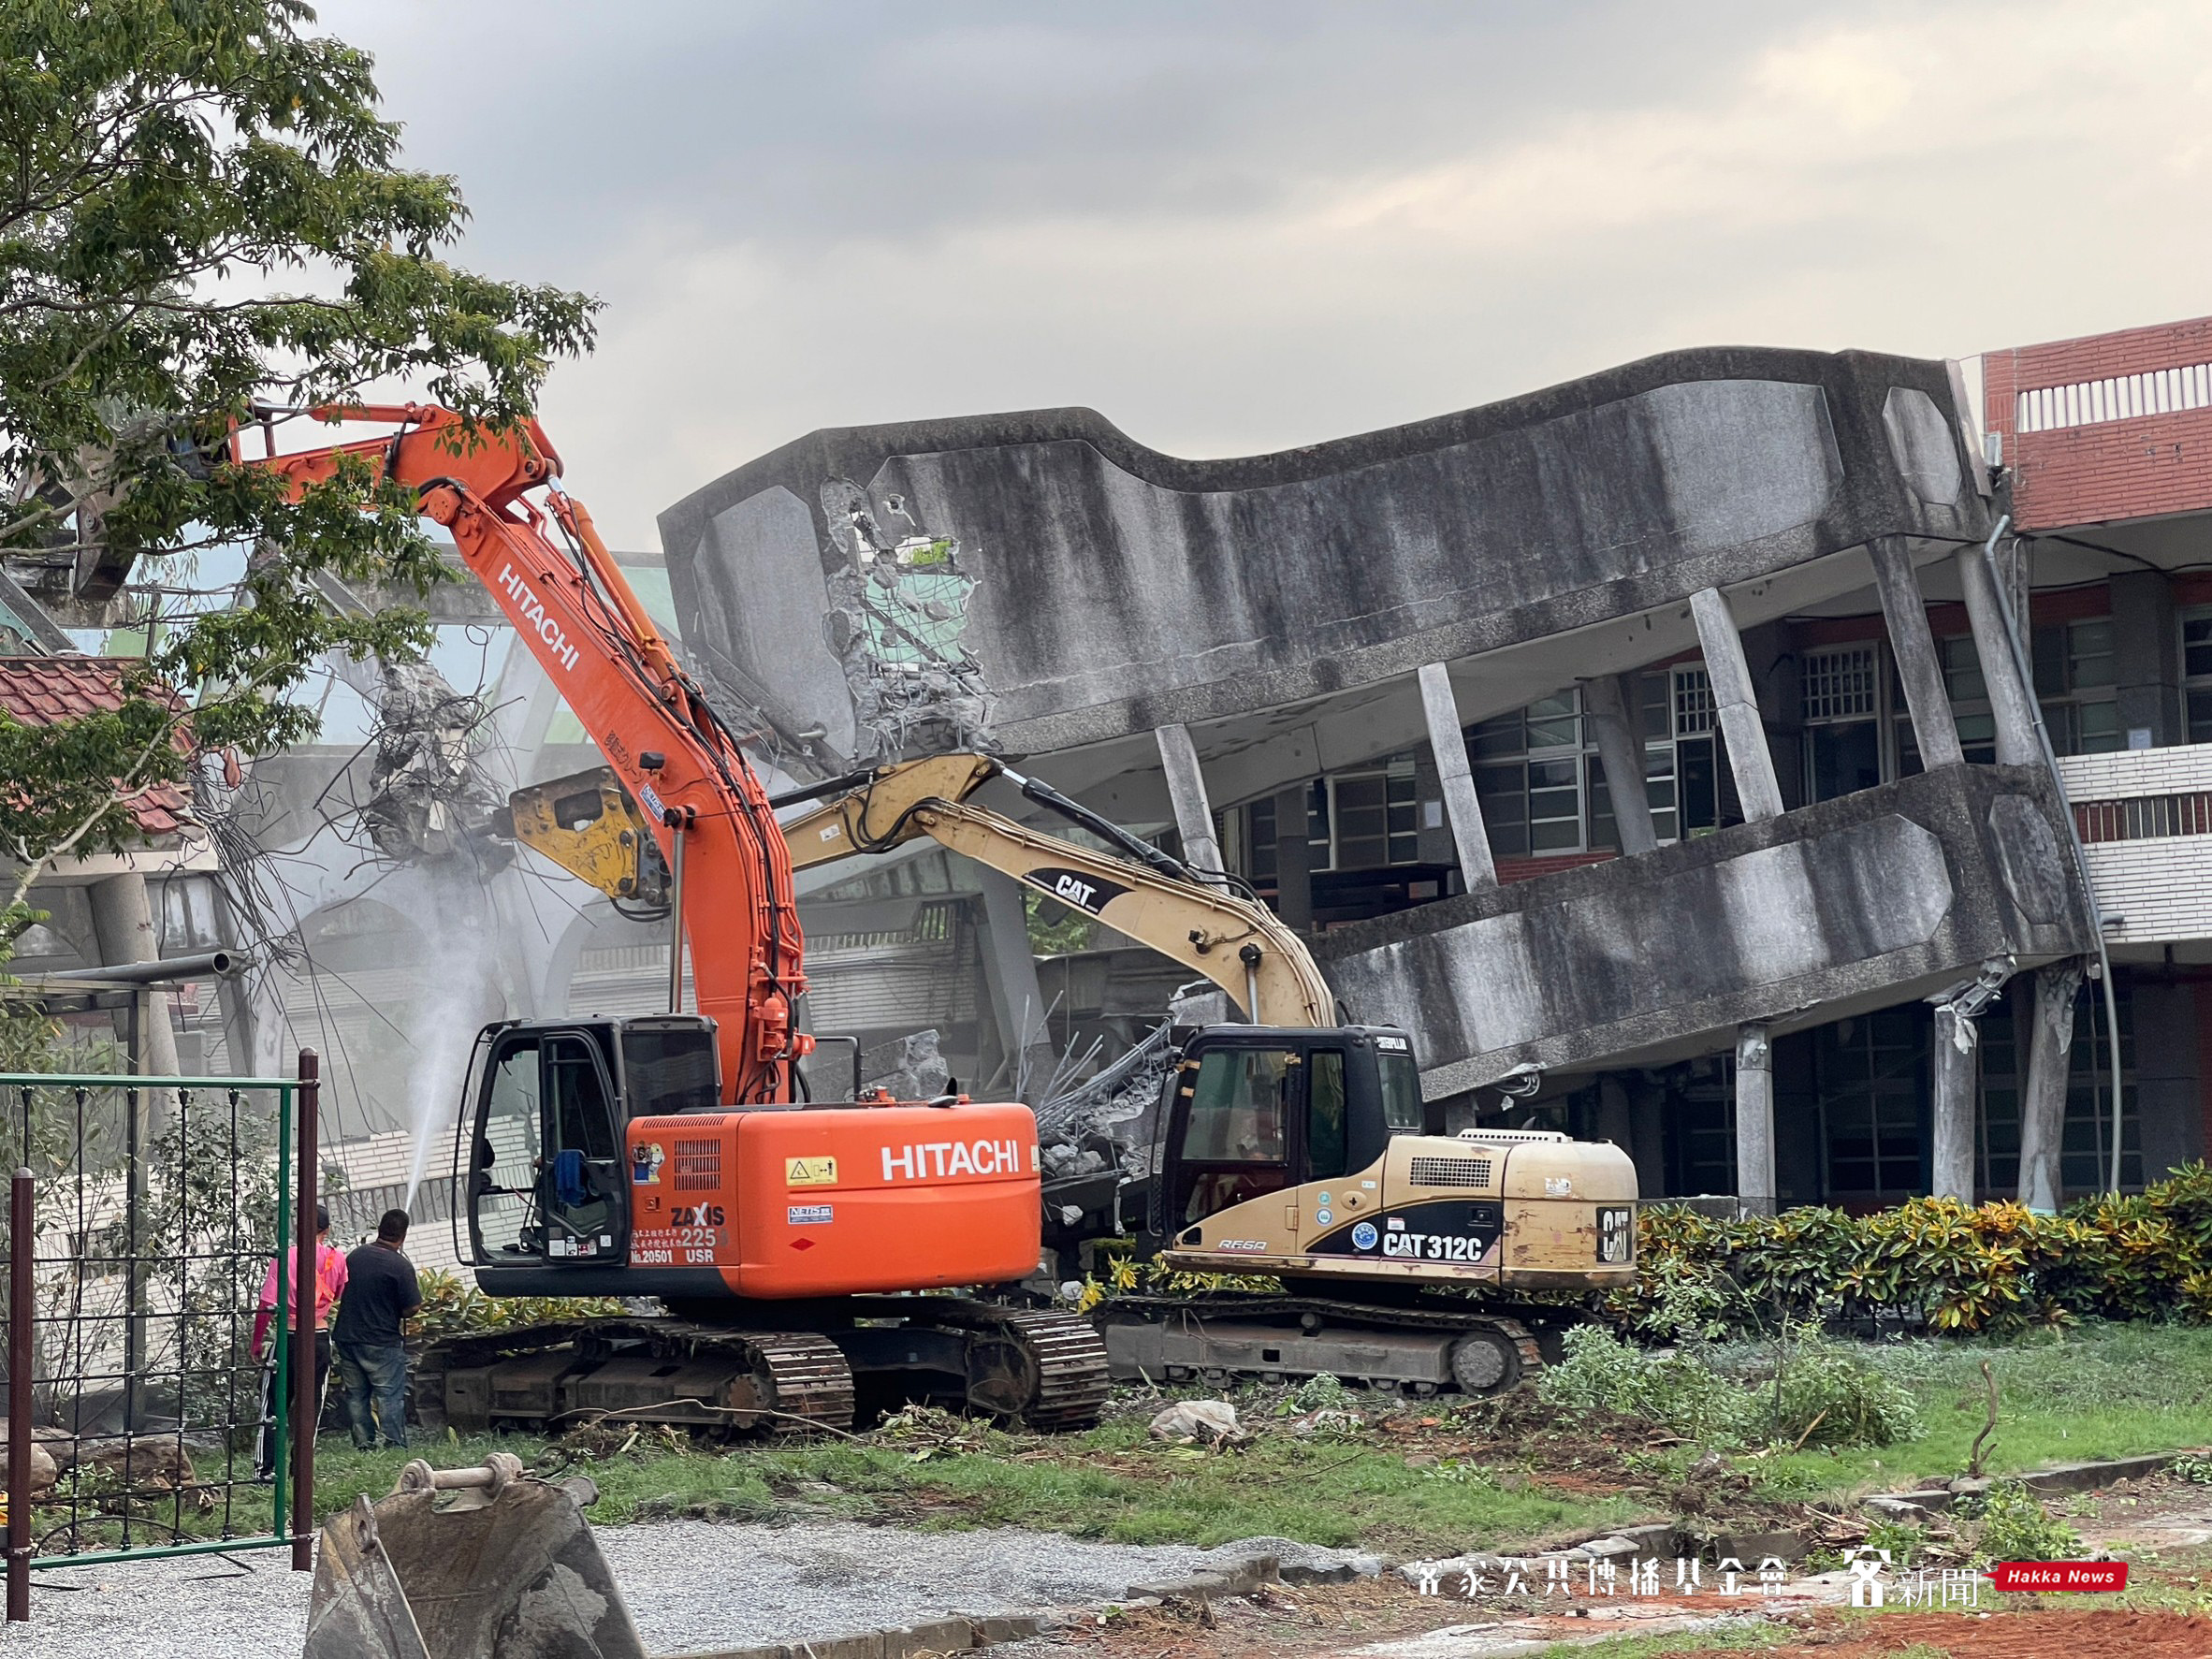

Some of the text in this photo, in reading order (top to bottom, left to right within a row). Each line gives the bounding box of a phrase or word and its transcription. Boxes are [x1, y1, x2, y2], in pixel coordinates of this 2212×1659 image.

[498, 562, 580, 672] HITACHI
[1055, 874, 1098, 907] CAT
[881, 1140, 1019, 1181] HITACHI
[671, 1201, 725, 1227] ZAXIS
[686, 1249, 714, 1263] USR
[1383, 1233, 1427, 1259] CAT
[1427, 1235, 1482, 1261] 312C
